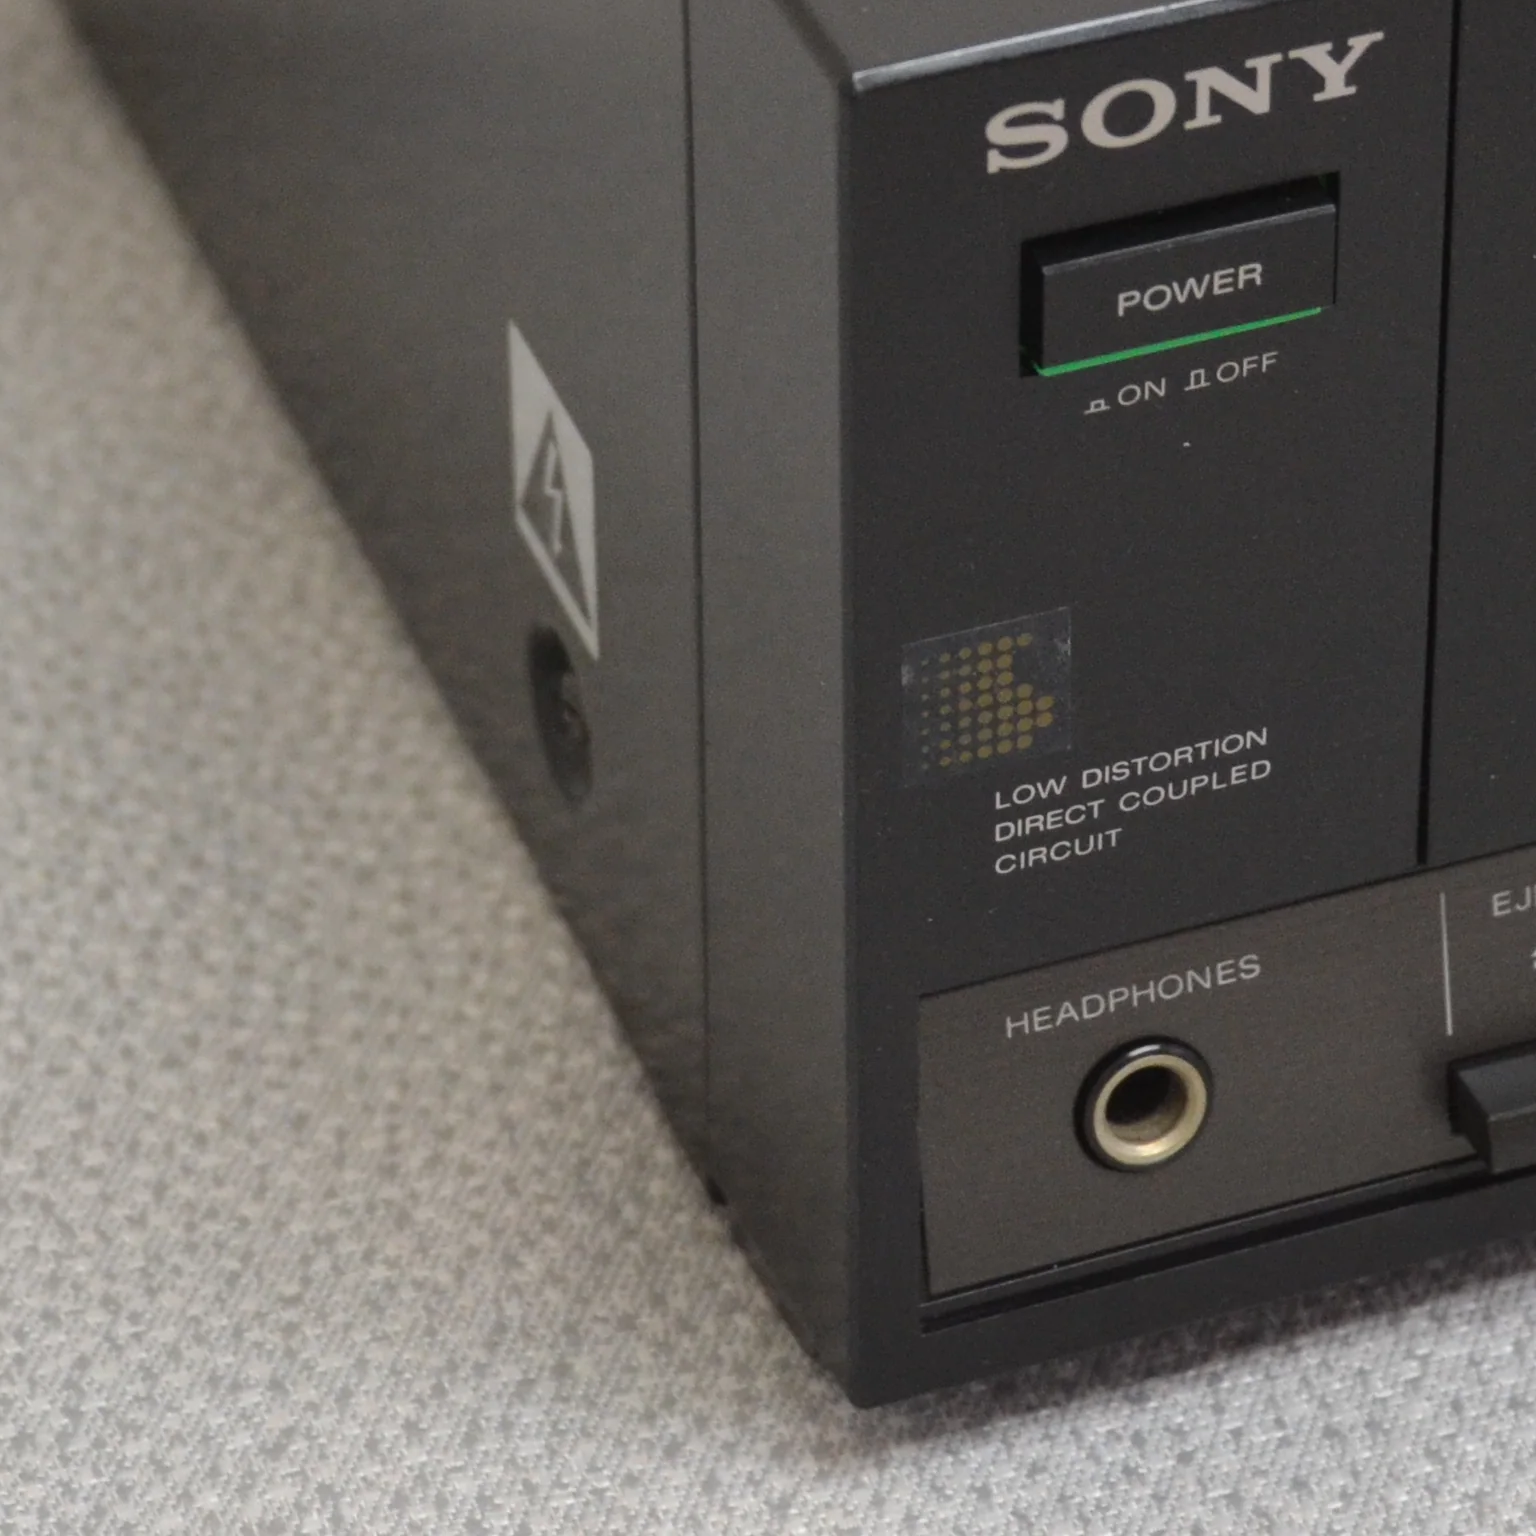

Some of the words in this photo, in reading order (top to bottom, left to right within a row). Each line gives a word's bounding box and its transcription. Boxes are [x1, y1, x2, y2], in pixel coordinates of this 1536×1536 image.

[985, 32, 1384, 173] SONY
[1117, 262, 1263, 317] POWER
[1117, 377, 1166, 408] ON
[1216, 351, 1279, 384] OFF
[995, 776, 1068, 810] LOW
[1082, 727, 1268, 790] DISTORTION
[995, 800, 1105, 843] DIRECT
[1119, 759, 1272, 813] COUPLED
[995, 828, 1123, 874] CIRCUIT
[1005, 954, 1262, 1038] HEADPHONES
